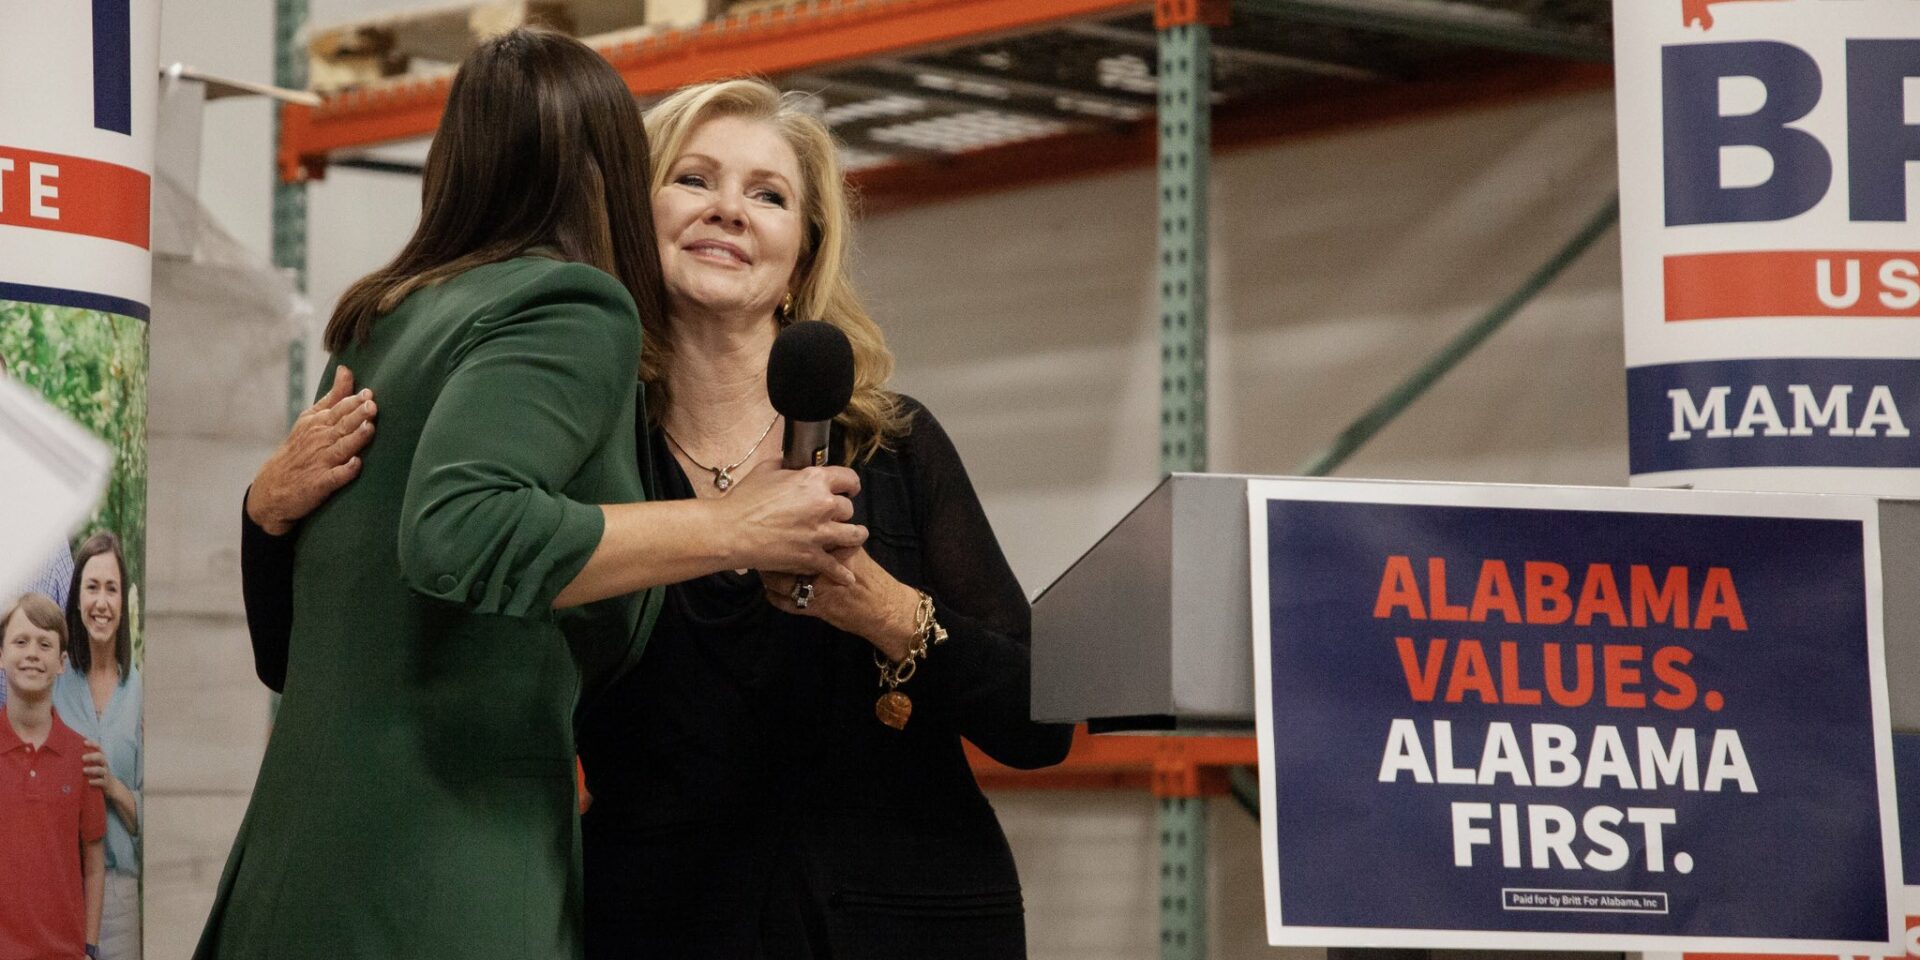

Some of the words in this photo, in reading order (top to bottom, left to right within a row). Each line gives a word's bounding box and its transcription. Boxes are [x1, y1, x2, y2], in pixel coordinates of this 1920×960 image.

[1667, 384, 1910, 441] MAMA
[1373, 555, 1748, 632] ALABAMA
[1395, 636, 1724, 713] VALUES.
[1378, 718, 1759, 794] ALABAMA
[1450, 801, 1694, 874] FIRST.
[1513, 893, 1533, 905] Paid
[1534, 894, 1548, 905] for
[1549, 895, 1560, 907] by
[1562, 896, 1582, 906] Britt
[1584, 896, 1599, 906] For
[1600, 896, 1641, 909] Alabama,
[1643, 898, 1658, 908] Inc
